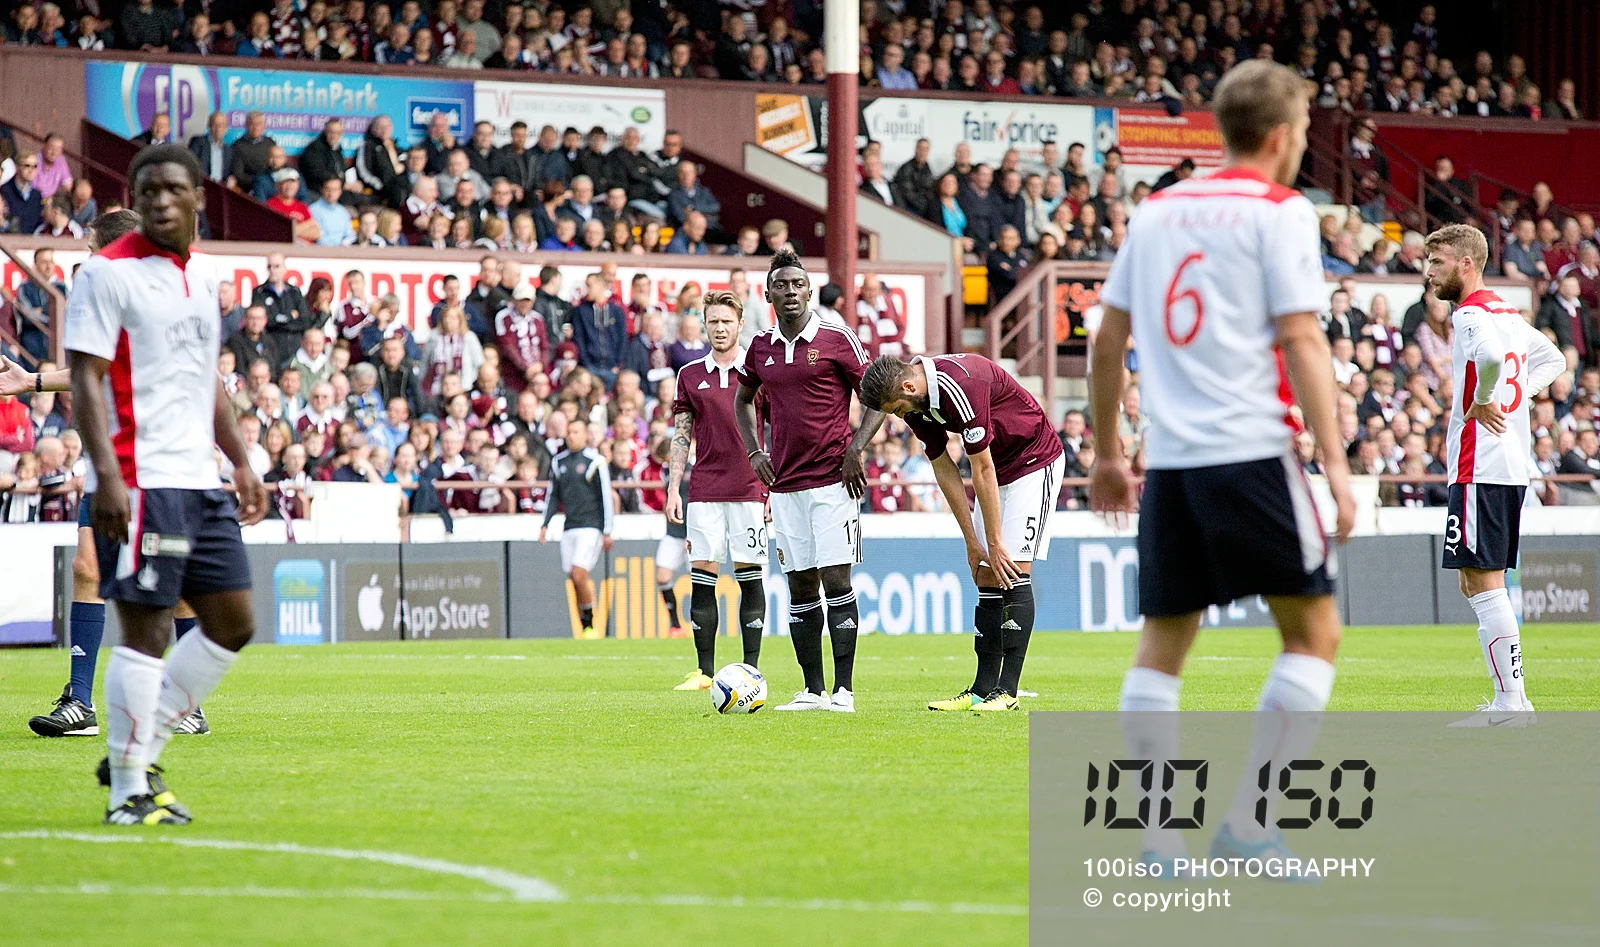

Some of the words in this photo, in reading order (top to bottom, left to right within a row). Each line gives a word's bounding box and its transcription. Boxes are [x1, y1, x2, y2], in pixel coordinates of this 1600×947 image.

[228, 75, 379, 112] FountainPark
[873, 114, 924, 141] Capital
[1164, 251, 1205, 348] 6
[1501, 352, 1528, 413] 3
[1024, 517, 1036, 541] 5
[1446, 514, 1462, 544] 3
[1546, 582, 1590, 614] Store
[279, 600, 322, 636] HILL
[393, 598, 438, 638] App
[439, 596, 490, 630] Store
[737, 686, 761, 707] mitre
